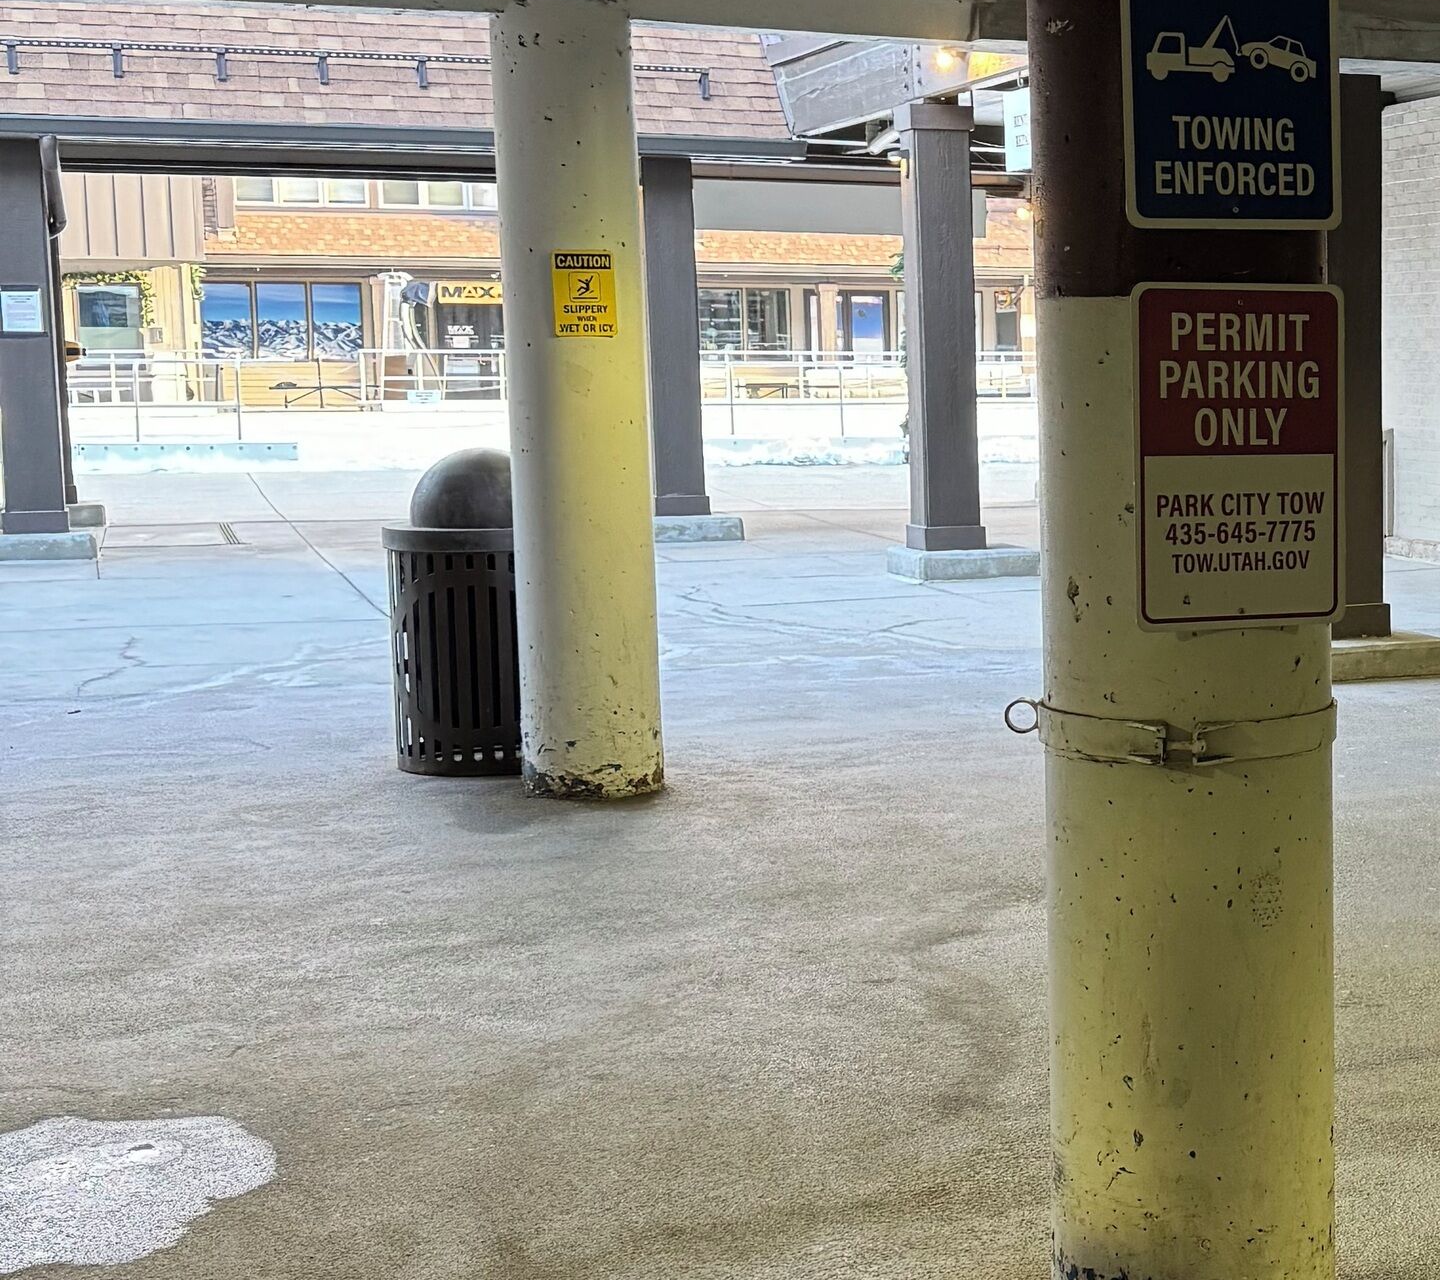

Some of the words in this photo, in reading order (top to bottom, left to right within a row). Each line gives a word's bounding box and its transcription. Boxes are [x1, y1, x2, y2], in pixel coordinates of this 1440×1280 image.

[1172, 115, 1295, 152] TOWING
[1155, 160, 1315, 196] ENFORCED
[556, 255, 610, 268] CAUTION
[563, 304, 608, 314] SLIPPERY
[559, 323, 580, 333] WET
[582, 323, 596, 333] OR
[599, 323, 615, 333] ICY
[1171, 312, 1310, 352] PERMIT
[1159, 360, 1320, 399] PARKING
[1194, 407, 1288, 447] ONLY
[1156, 493, 1215, 518] PARK
[1221, 492, 1270, 517] CITY
[1276, 491, 1325, 515] TOW
[1165, 520, 1316, 546] 435-645-7775
[1172, 550, 1310, 574] TOW.UTAH.GOV
